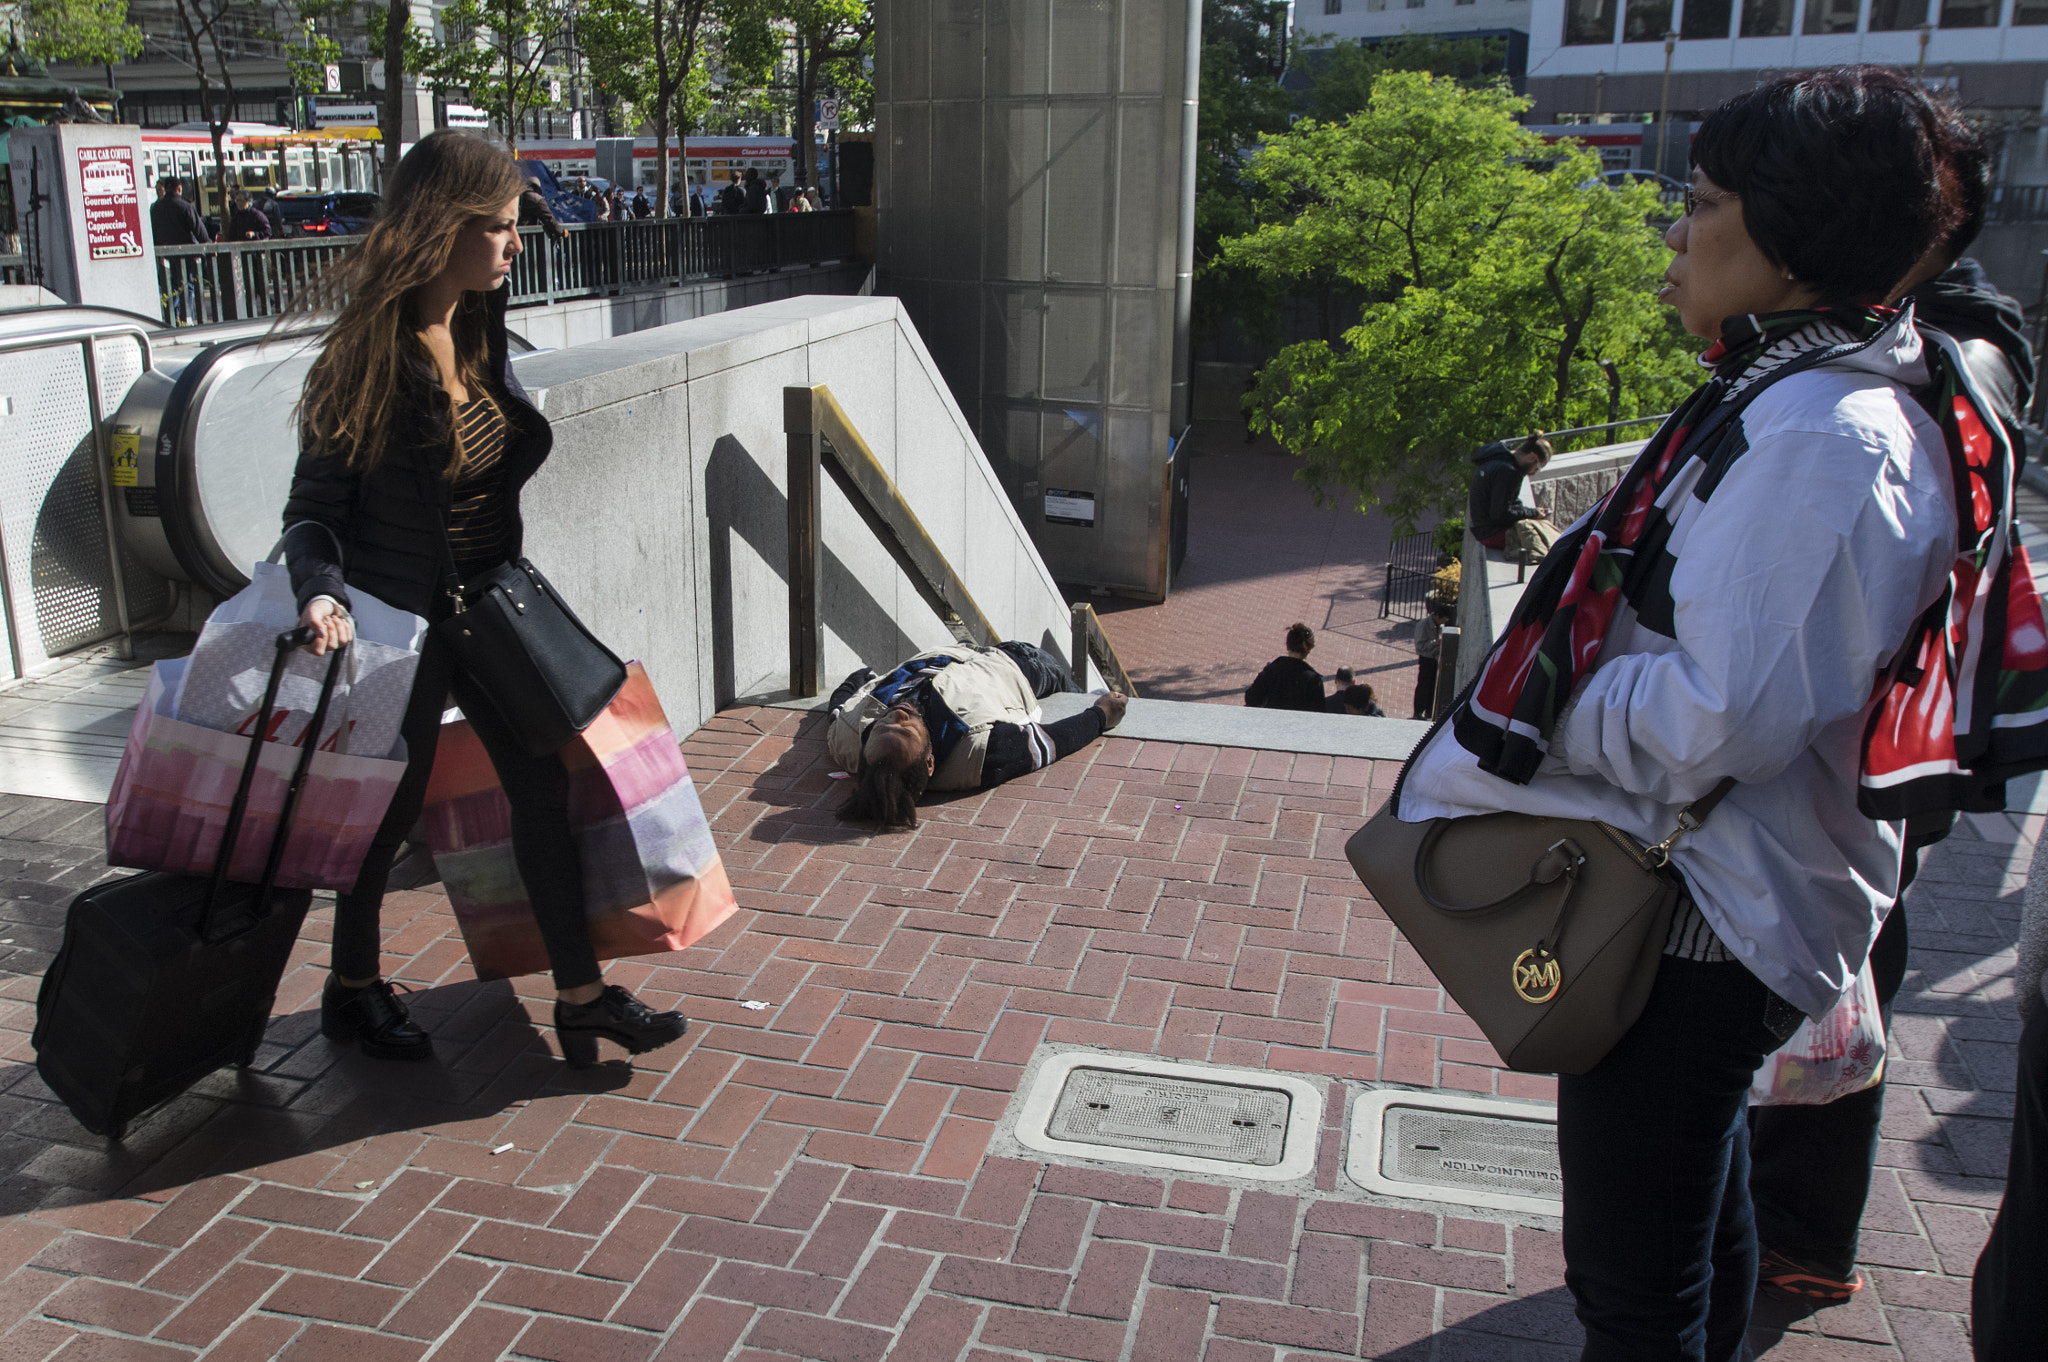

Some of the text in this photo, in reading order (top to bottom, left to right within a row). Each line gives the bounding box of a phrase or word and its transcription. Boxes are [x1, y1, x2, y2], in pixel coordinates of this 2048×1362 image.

[356, 111, 375, 121] rack
[79, 147, 132, 161] CABLE CAR COFFEE
[758, 148, 768, 156] Air
[84, 195, 137, 206] Gourmet Coffees
[86, 208, 115, 221] Espresso
[87, 220, 127, 233] Cappuccino
[88, 233, 115, 244] Pastries
[1144, 1089, 1209, 1103] ELECTRIC
[1441, 1160, 1563, 1183] OMMUNICATION
